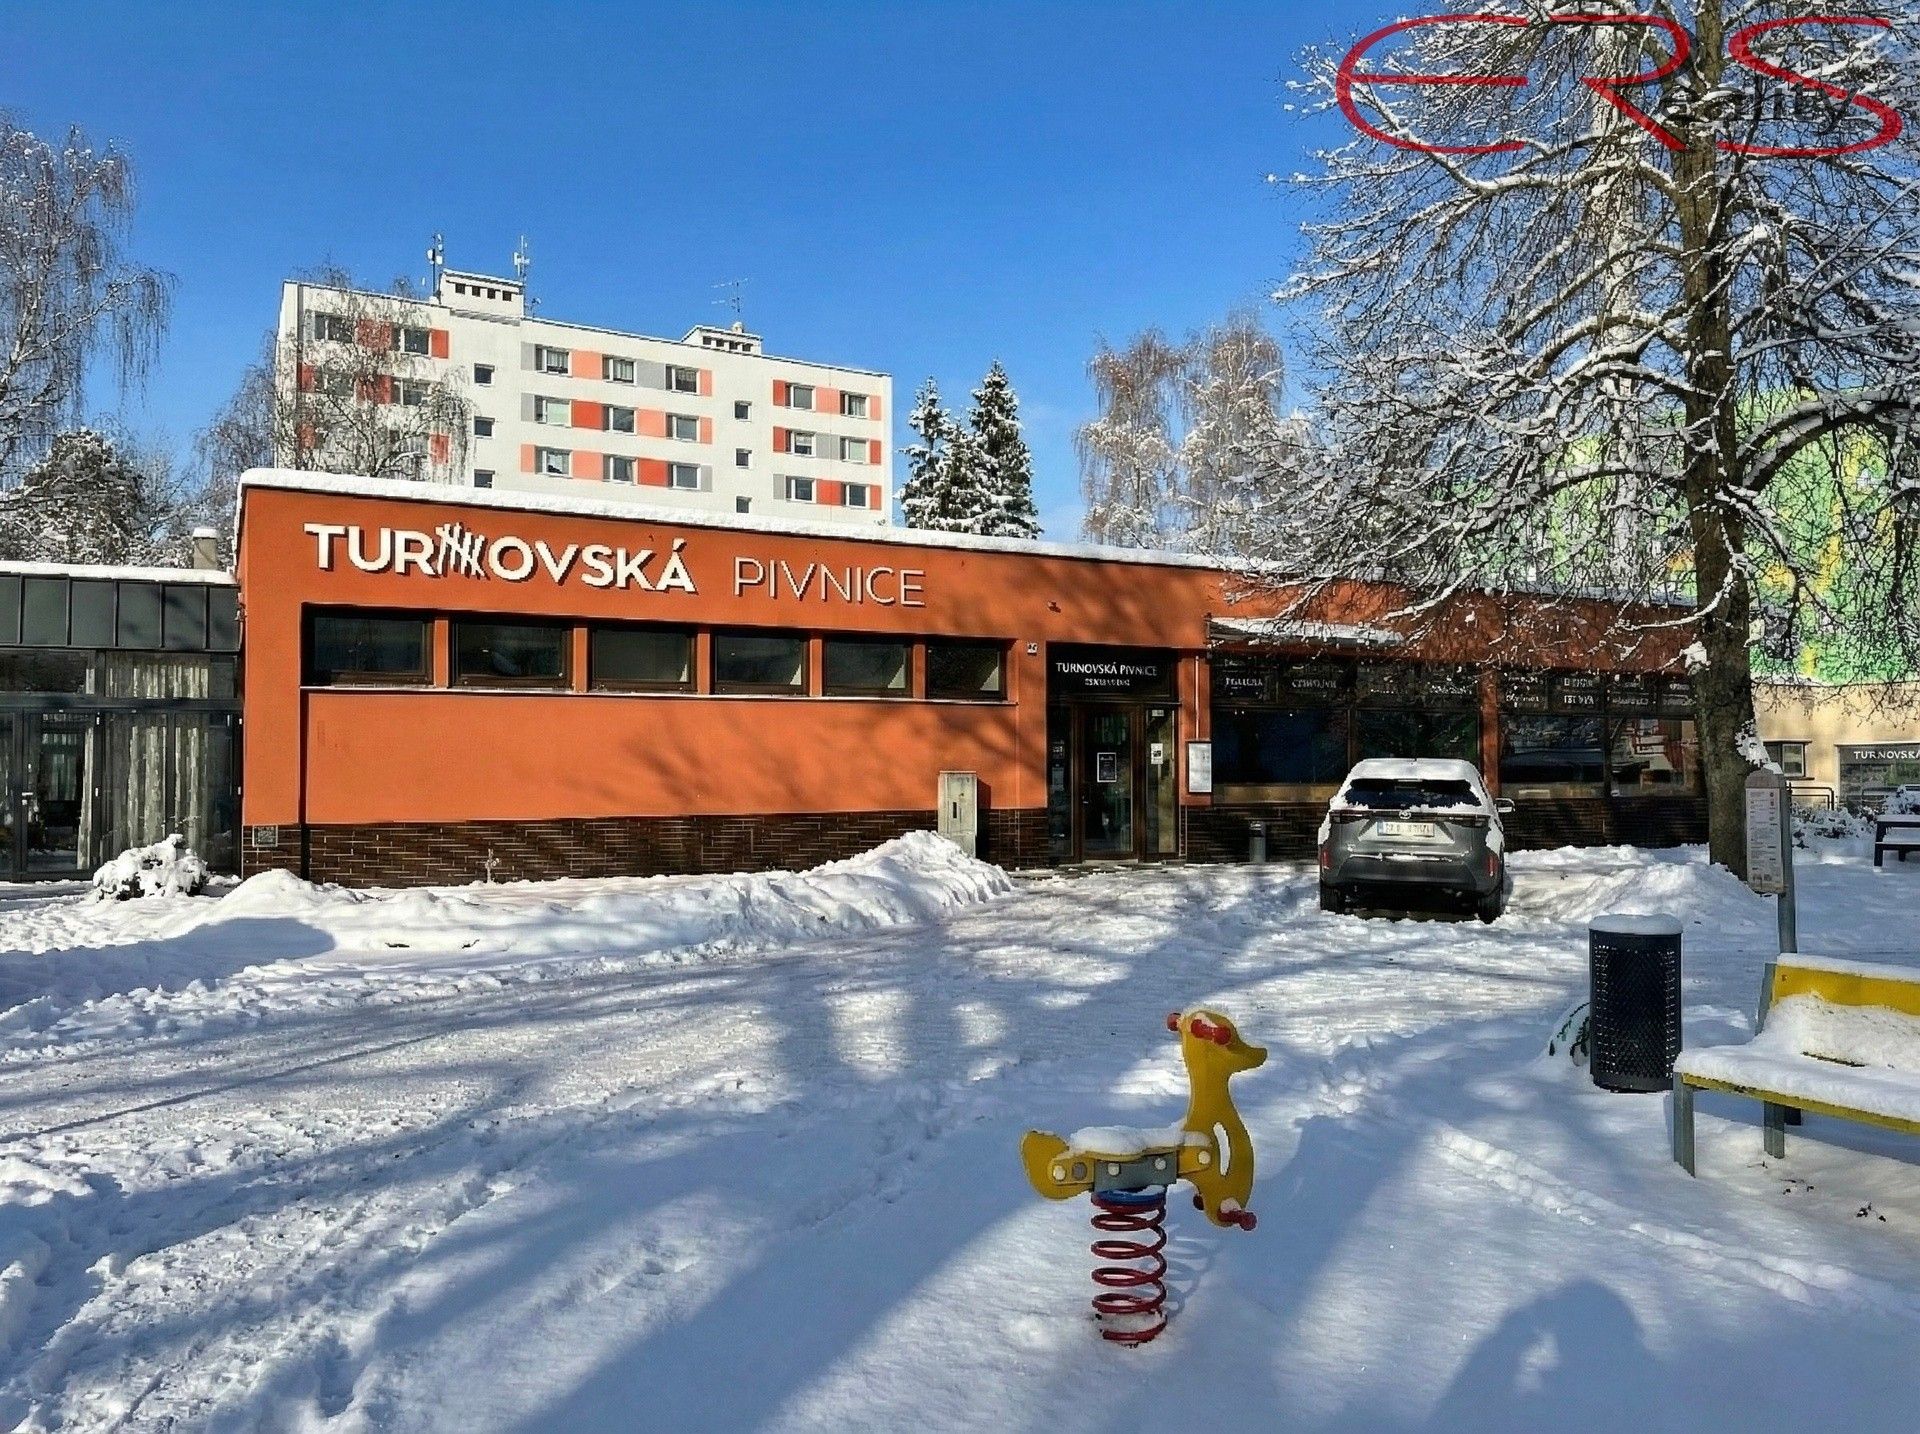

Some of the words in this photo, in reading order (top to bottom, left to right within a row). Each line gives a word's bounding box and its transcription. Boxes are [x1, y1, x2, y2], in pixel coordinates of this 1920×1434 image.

[303, 522, 697, 593] TURNOVSKÁ
[734, 556, 926, 606] PIVNICE
[1055, 661, 1118, 675] TURNOVSKÁ
[1119, 664, 1158, 677] PIVNICE
